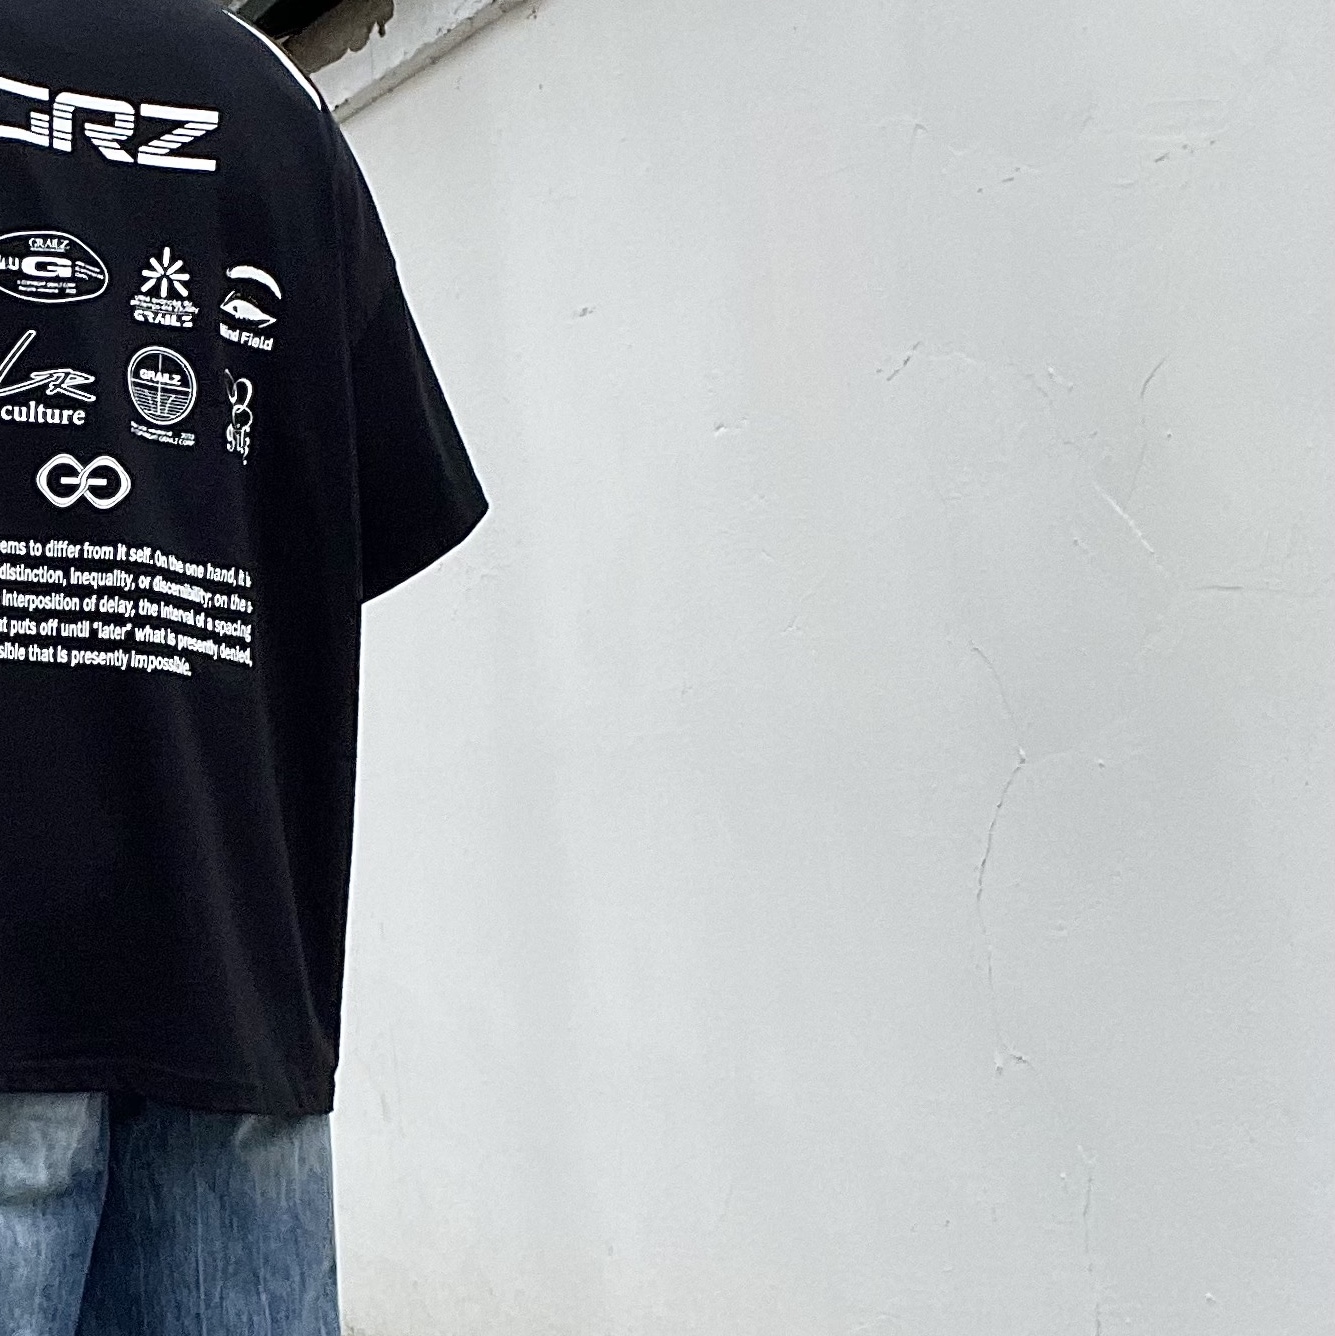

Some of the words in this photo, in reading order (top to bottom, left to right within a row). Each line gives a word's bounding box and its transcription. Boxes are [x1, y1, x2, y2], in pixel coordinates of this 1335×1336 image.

[240, 331, 274, 350] Field
[139, 369, 181, 386] GRAILZ
[0, 401, 86, 425] culture
[29, 540, 43, 556] to
[45, 540, 81, 558] differ
[83, 542, 114, 560] from
[116, 543, 127, 561] it
[129, 547, 154, 565] self.
[155, 550, 168, 568] On
[168, 555, 184, 573] the
[185, 563, 205, 578] one
[206, 563, 237, 587] hand,
[0, 563, 67, 586] distinction,
[70, 566, 136, 591] inequality,
[138, 575, 151, 589] or
[214, 593, 228, 609] on
[230, 593, 248, 612] the
[2, 589, 80, 612] interposition
[83, 594, 97, 612] of
[99, 595, 136, 617] delay,
[138, 598, 159, 617] the
[160, 601, 194, 626] interval
[195, 612, 205, 628] of
[206, 617, 213, 631] a
[215, 620, 251, 643] spacing
[10, 619, 37, 637] puts
[39, 619, 58, 636] off
[61, 620, 90, 638] until
[135, 625, 165, 644] what
[167, 628, 176, 647] is
[177, 634, 218, 660] presently
[219, 643, 253, 668] denied,
[28, 644, 54, 663] that
[56, 645, 68, 664] is
[71, 649, 129, 670] presently
